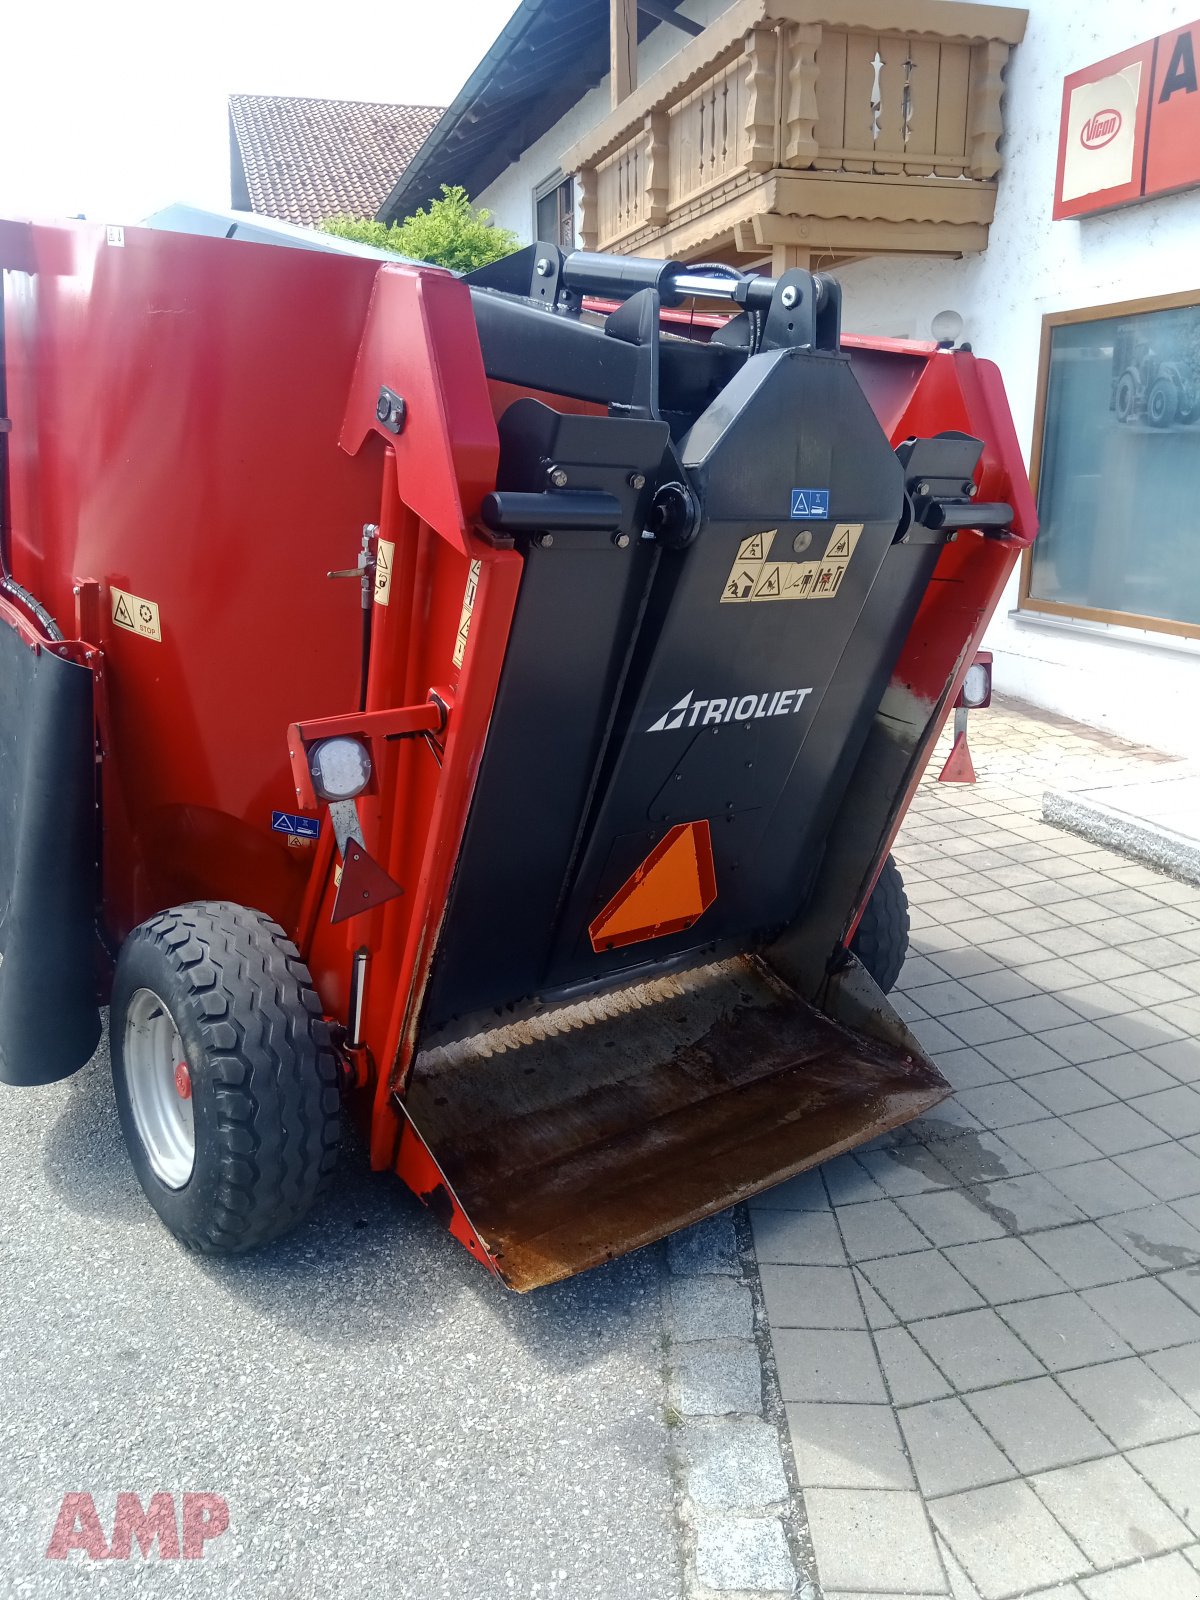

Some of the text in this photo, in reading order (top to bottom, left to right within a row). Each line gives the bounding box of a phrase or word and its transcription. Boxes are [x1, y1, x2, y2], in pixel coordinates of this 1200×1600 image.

[1158, 30, 1198, 104] A
[1085, 115, 1117, 143] Vicon
[139, 624, 156, 635] STOP
[688, 688, 813, 726] TRIOLIET
